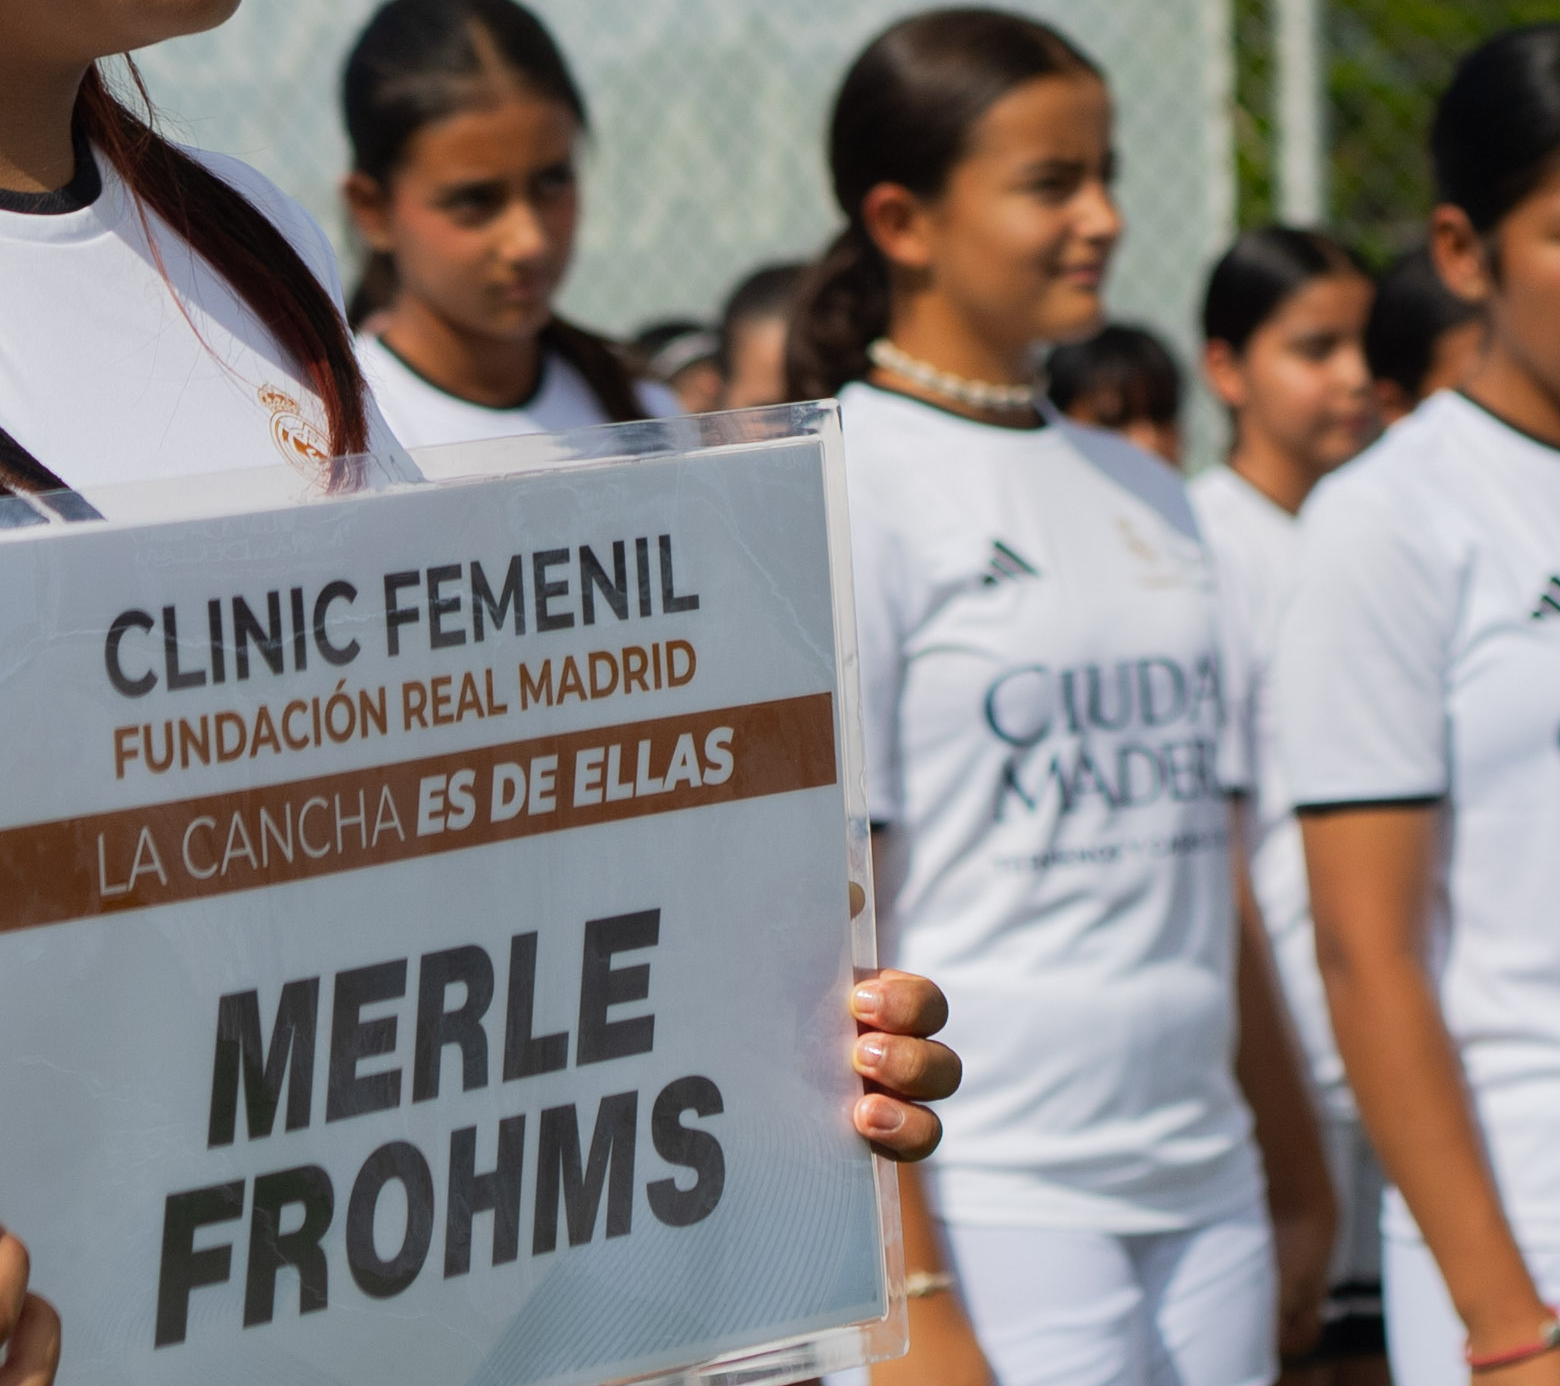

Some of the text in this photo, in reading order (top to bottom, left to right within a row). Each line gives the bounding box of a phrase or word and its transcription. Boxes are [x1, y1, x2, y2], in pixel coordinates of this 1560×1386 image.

[104, 579, 362, 699] CLINIC
[383, 533, 700, 658] FEMENIL
[113, 638, 698, 781] FUNDACIÓN REAL MADRID
[984, 653, 1227, 748] CIUDA
[96, 726, 736, 896] LA CANCHA ES DE ELLAS
[205, 906, 662, 1151] MERLE
[153, 1075, 726, 1351] FROHMS
